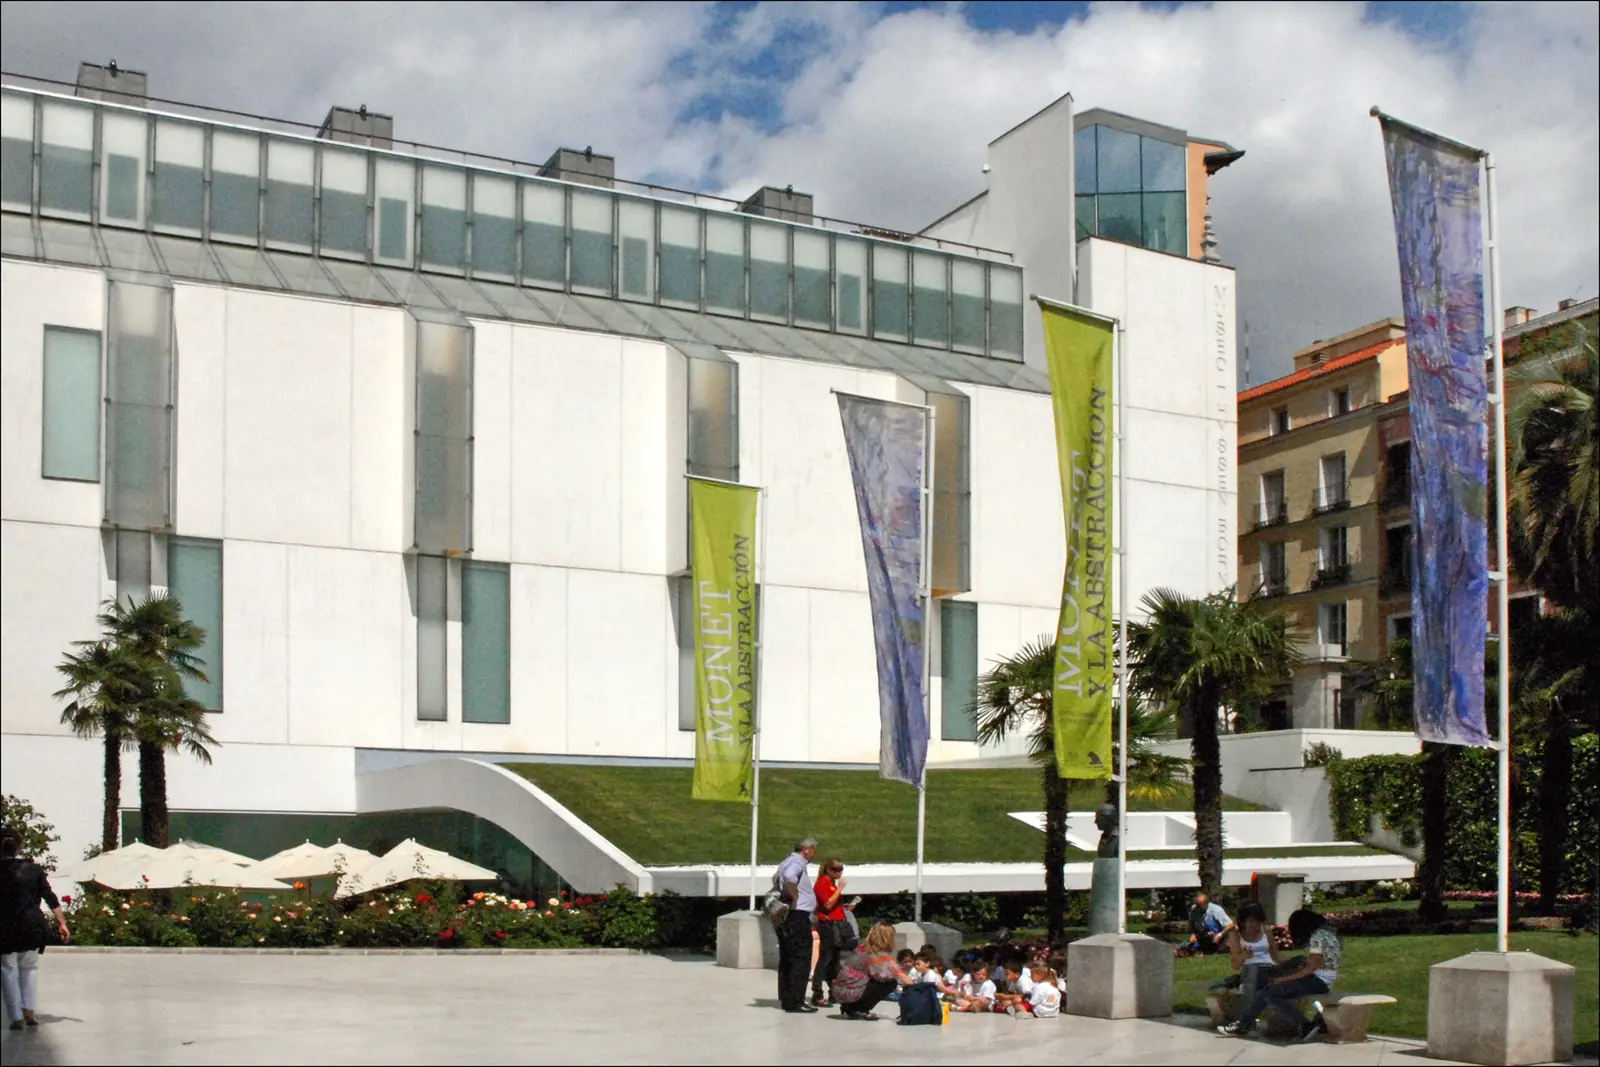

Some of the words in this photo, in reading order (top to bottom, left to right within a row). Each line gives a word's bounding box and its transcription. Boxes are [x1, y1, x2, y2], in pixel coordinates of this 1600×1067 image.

[1214, 285, 1227, 372] MUSEO
[1217, 517, 1228, 587] BORN
[733, 534, 752, 691] ABSTRACCIÓN
[700, 580, 733, 746] MONET
[1086, 632, 1107, 670] LA
[738, 695, 752, 729] LA
[1089, 675, 1107, 698] Y
[739, 732, 752, 748] Y
